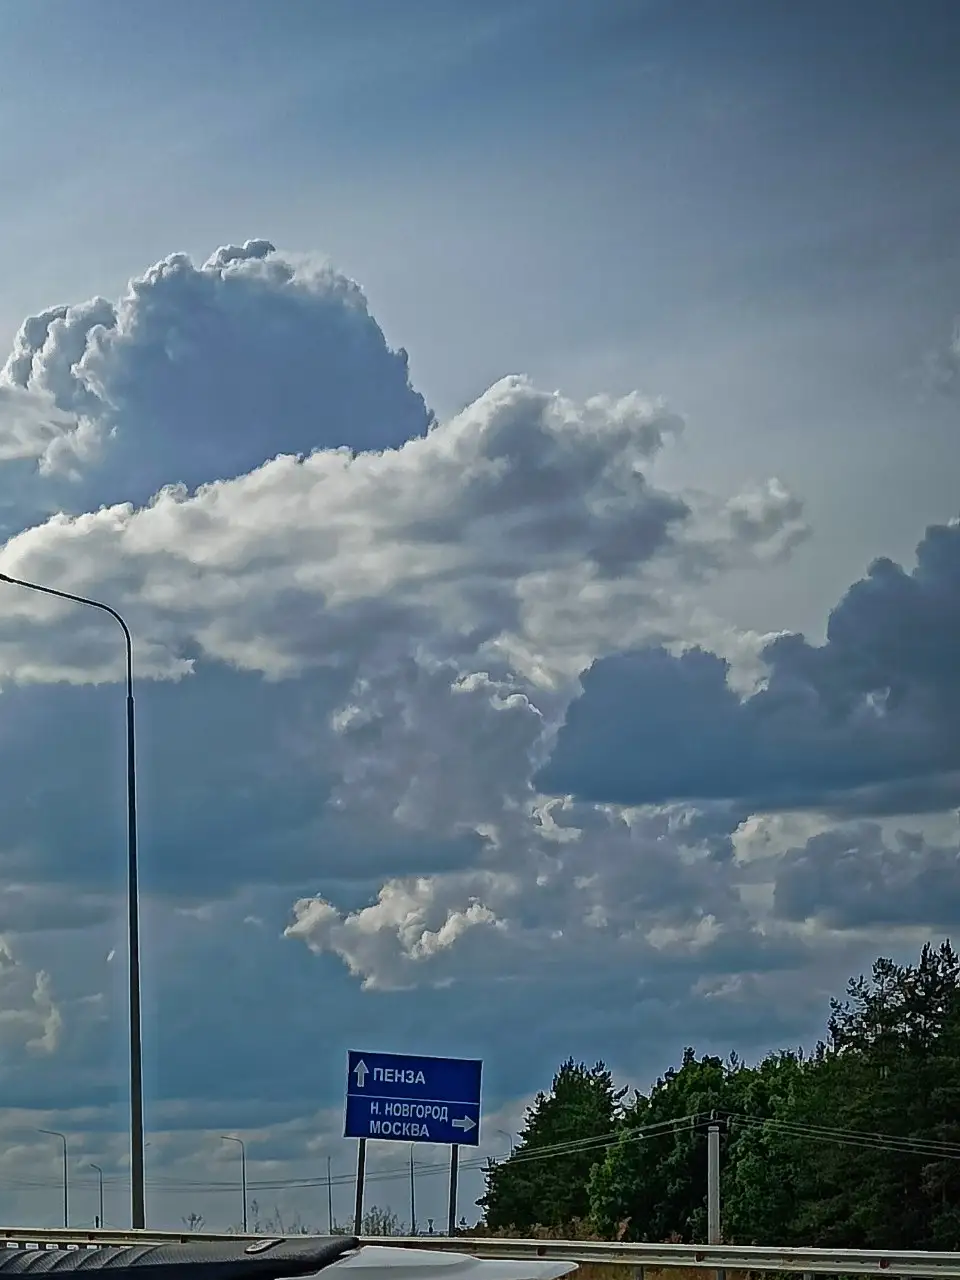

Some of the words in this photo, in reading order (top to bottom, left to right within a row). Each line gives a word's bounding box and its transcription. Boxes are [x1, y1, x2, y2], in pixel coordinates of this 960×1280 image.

[373, 1067, 426, 1085] ПЕНЗА
[370, 1101, 382, 1115] Н.
[384, 1102, 449, 1123] НОВГОРОД
[369, 1120, 430, 1138] МОСКВА
